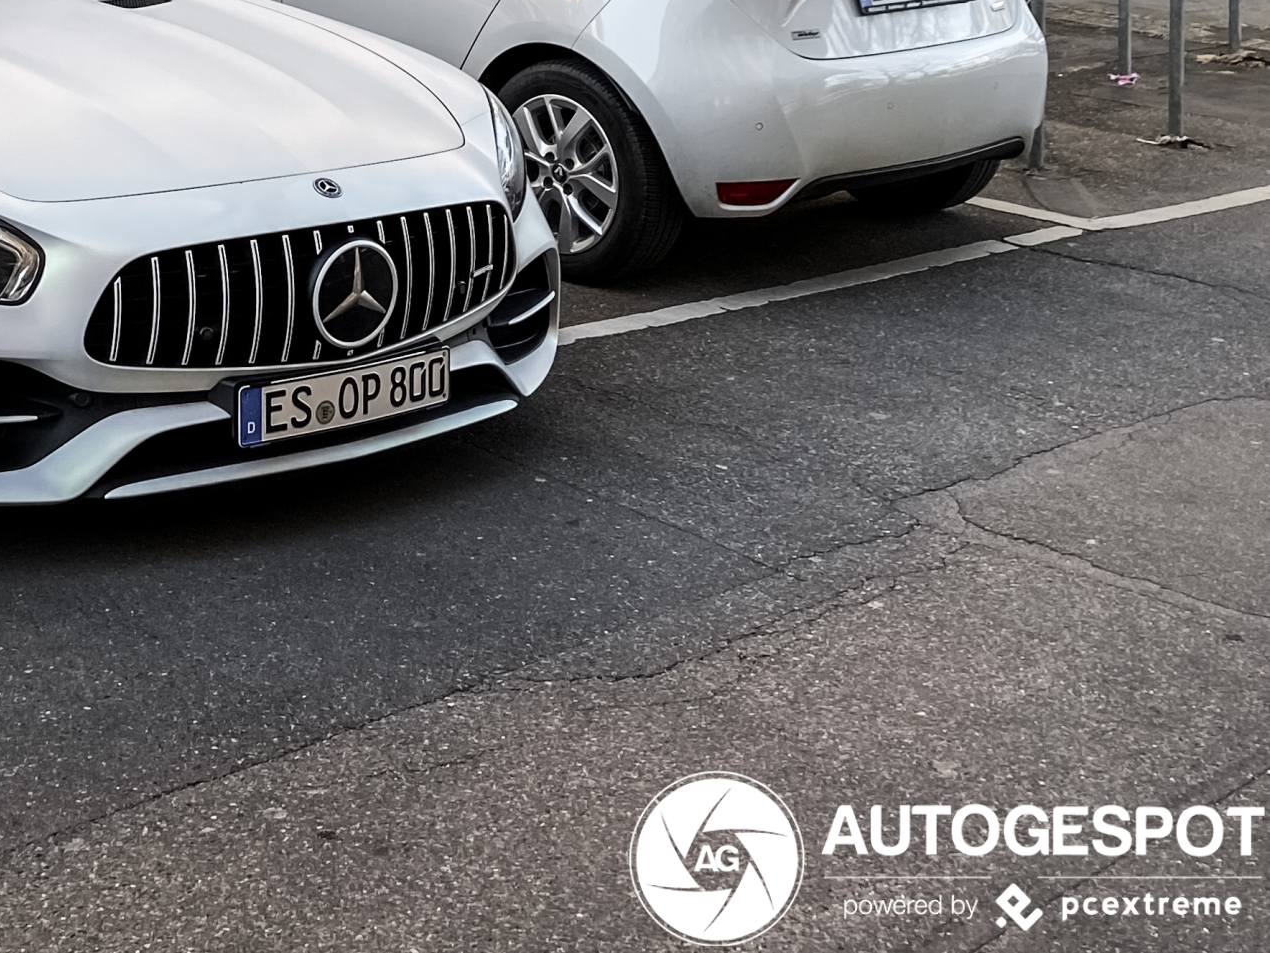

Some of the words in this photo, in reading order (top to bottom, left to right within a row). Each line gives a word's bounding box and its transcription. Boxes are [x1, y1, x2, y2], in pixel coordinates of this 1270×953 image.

[265, 386, 312, 434] ES
[339, 373, 381, 419] OP
[390, 357, 445, 408] 800
[247, 421, 256, 434] D
